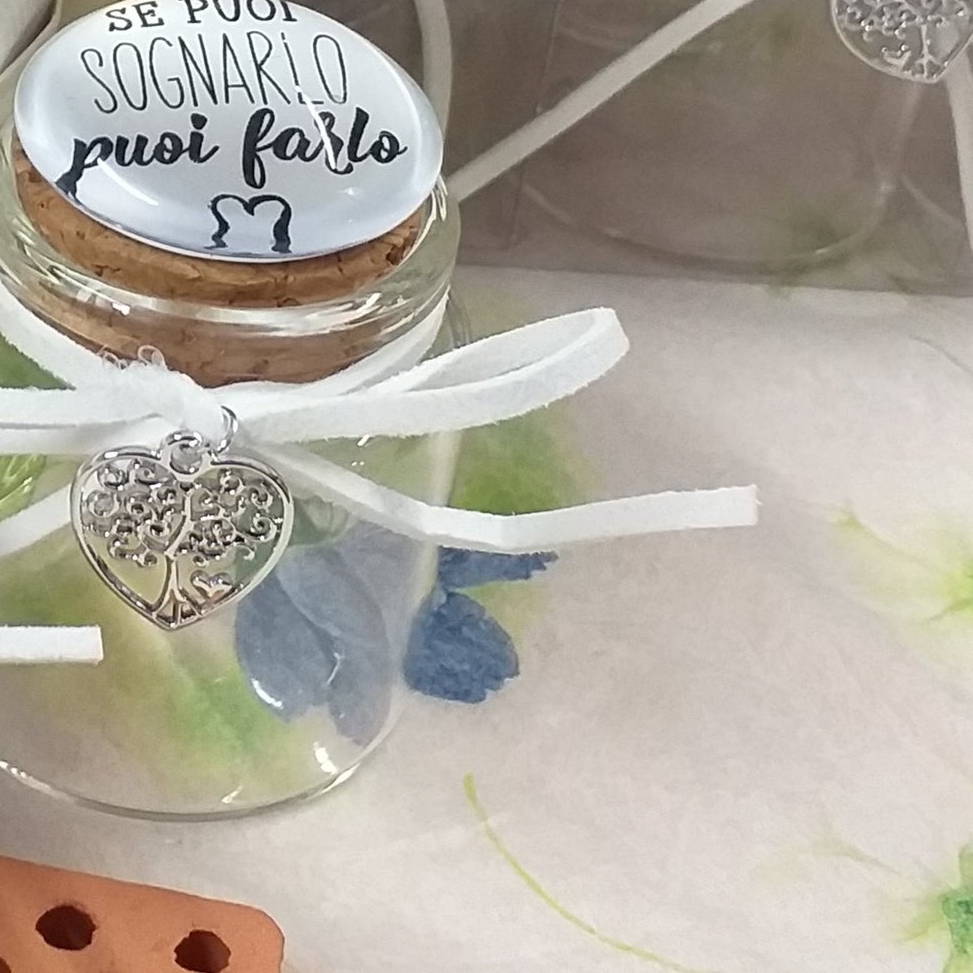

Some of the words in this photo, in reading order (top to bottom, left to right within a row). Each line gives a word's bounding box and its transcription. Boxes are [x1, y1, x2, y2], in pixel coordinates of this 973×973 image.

[105, 0, 165, 33] SE
[54, 112, 221, 205] puoi
[241, 105, 408, 190] farlo
